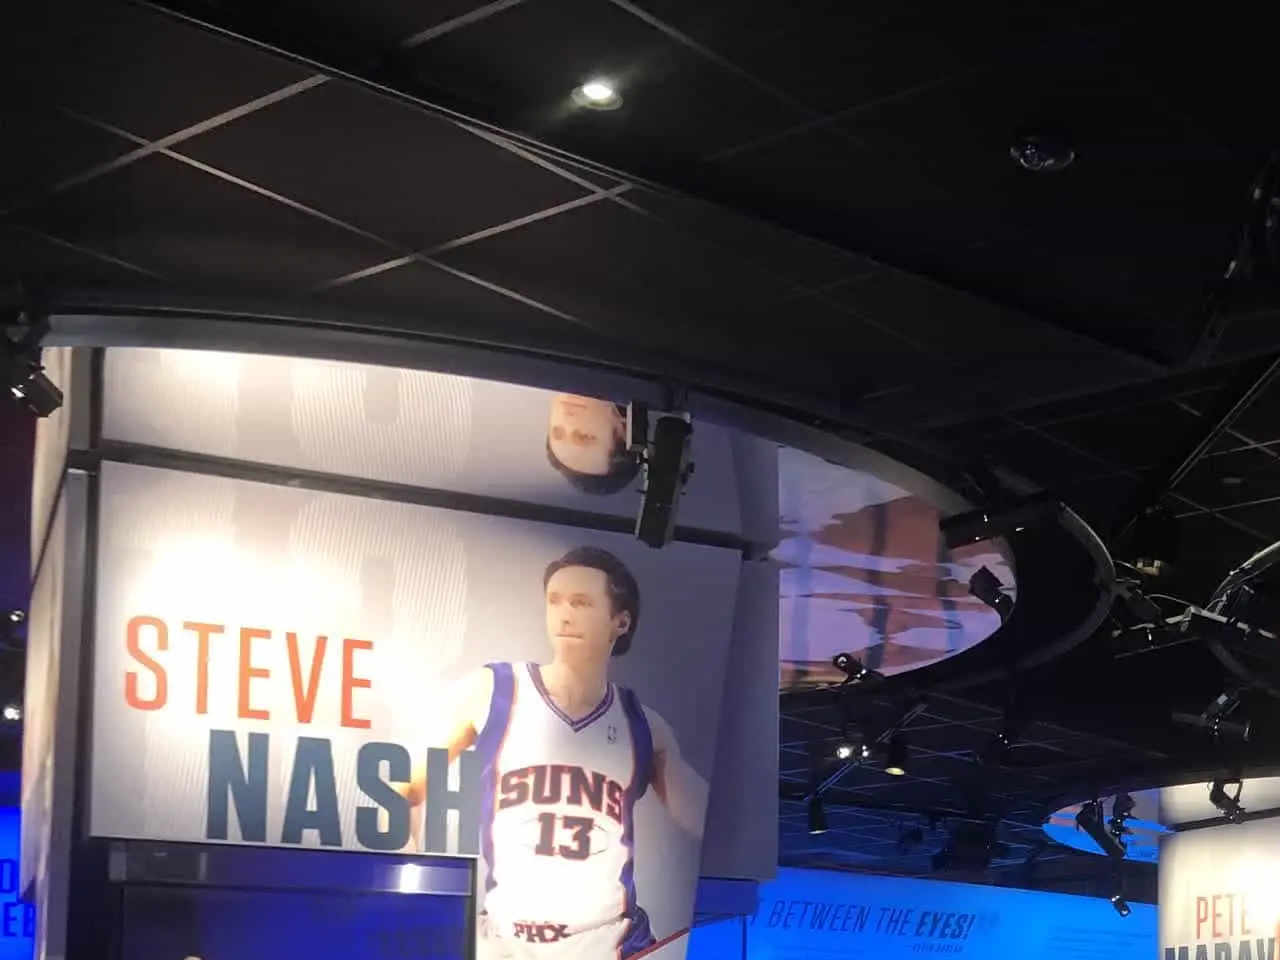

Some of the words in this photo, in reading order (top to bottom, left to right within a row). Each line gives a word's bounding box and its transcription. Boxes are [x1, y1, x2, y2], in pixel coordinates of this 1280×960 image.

[124, 615, 374, 730] STEVE
[205, 729, 482, 855] NASH
[500, 764, 624, 823] SUNS
[533, 812, 595, 861] 13
[768, 900, 873, 933] BETWEEN
[875, 907, 915, 936] THE
